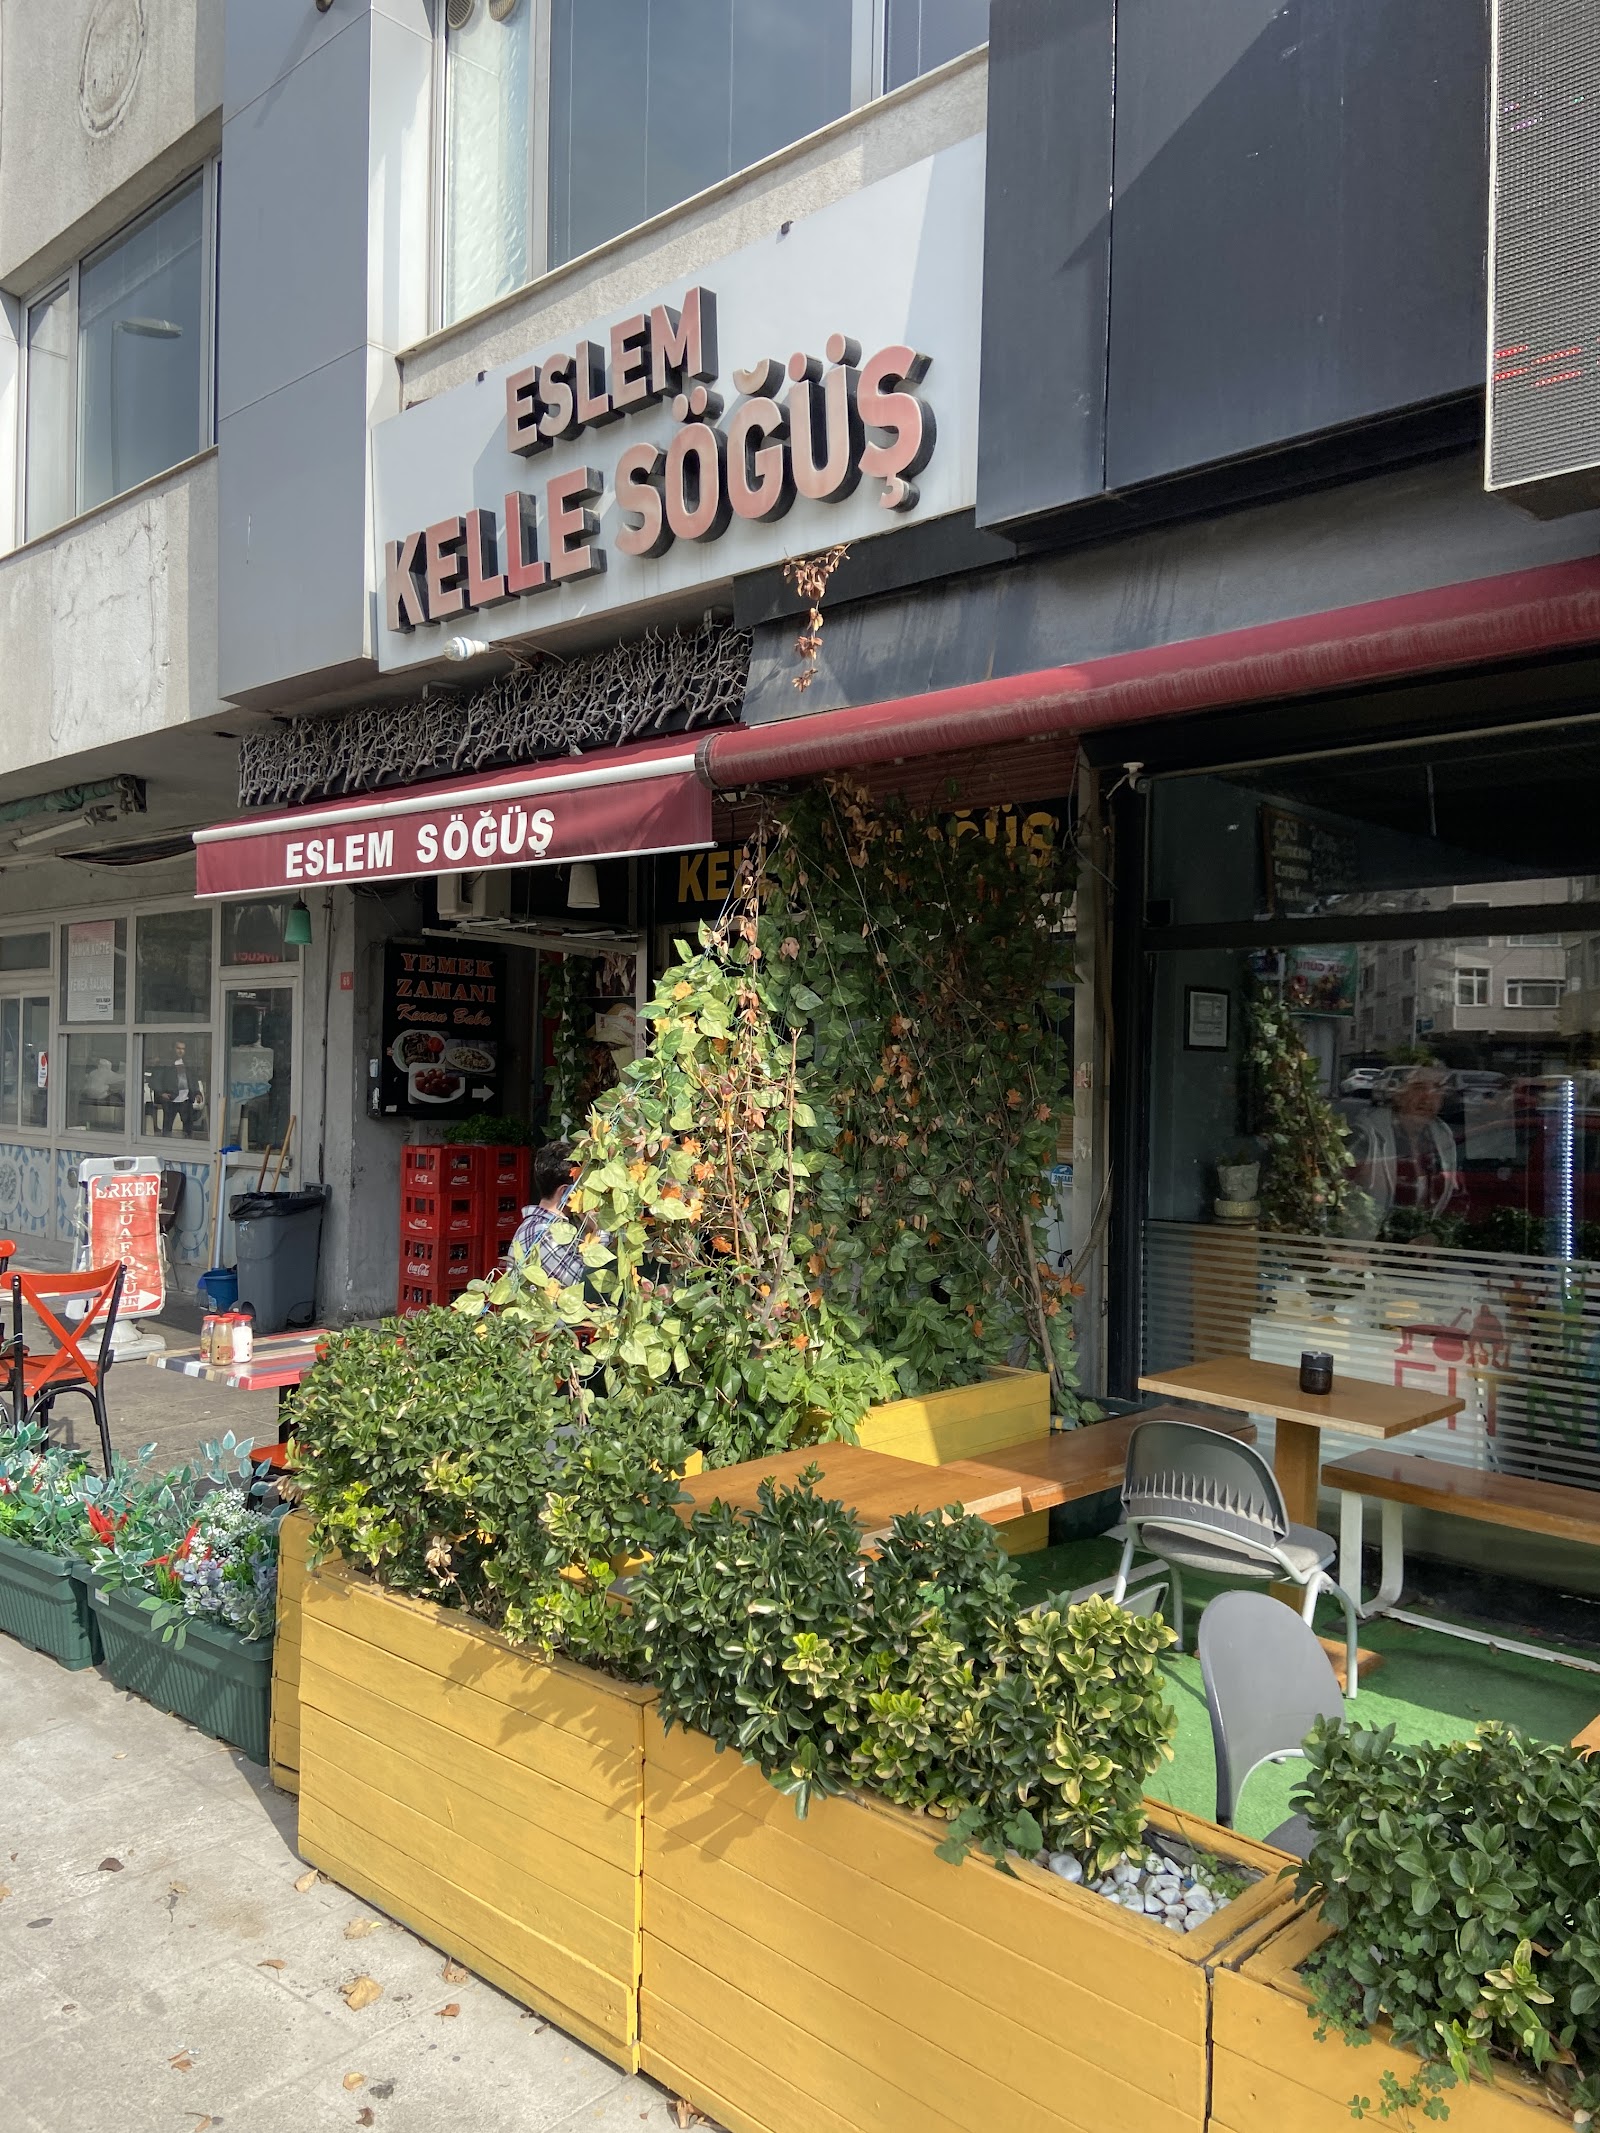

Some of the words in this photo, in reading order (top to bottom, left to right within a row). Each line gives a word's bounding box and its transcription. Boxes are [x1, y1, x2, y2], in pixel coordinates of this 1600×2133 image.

[506, 286, 717, 457] ESLEM
[385, 466, 606, 633] KELLE
[615, 333, 936, 559] SÖĞÜŞ
[286, 829, 394, 879] ESLEM
[416, 805, 556, 864] SÖĞÜŞ
[401, 952, 494, 978] YEMEK
[396, 978, 497, 1003] ZAMANI
[397, 1003, 448, 1023] Kenan
[453, 1007, 492, 1026] Baba
[95, 1181, 157, 1199] ERKEK
[407, 1261, 430, 1277] Coca-Cola
